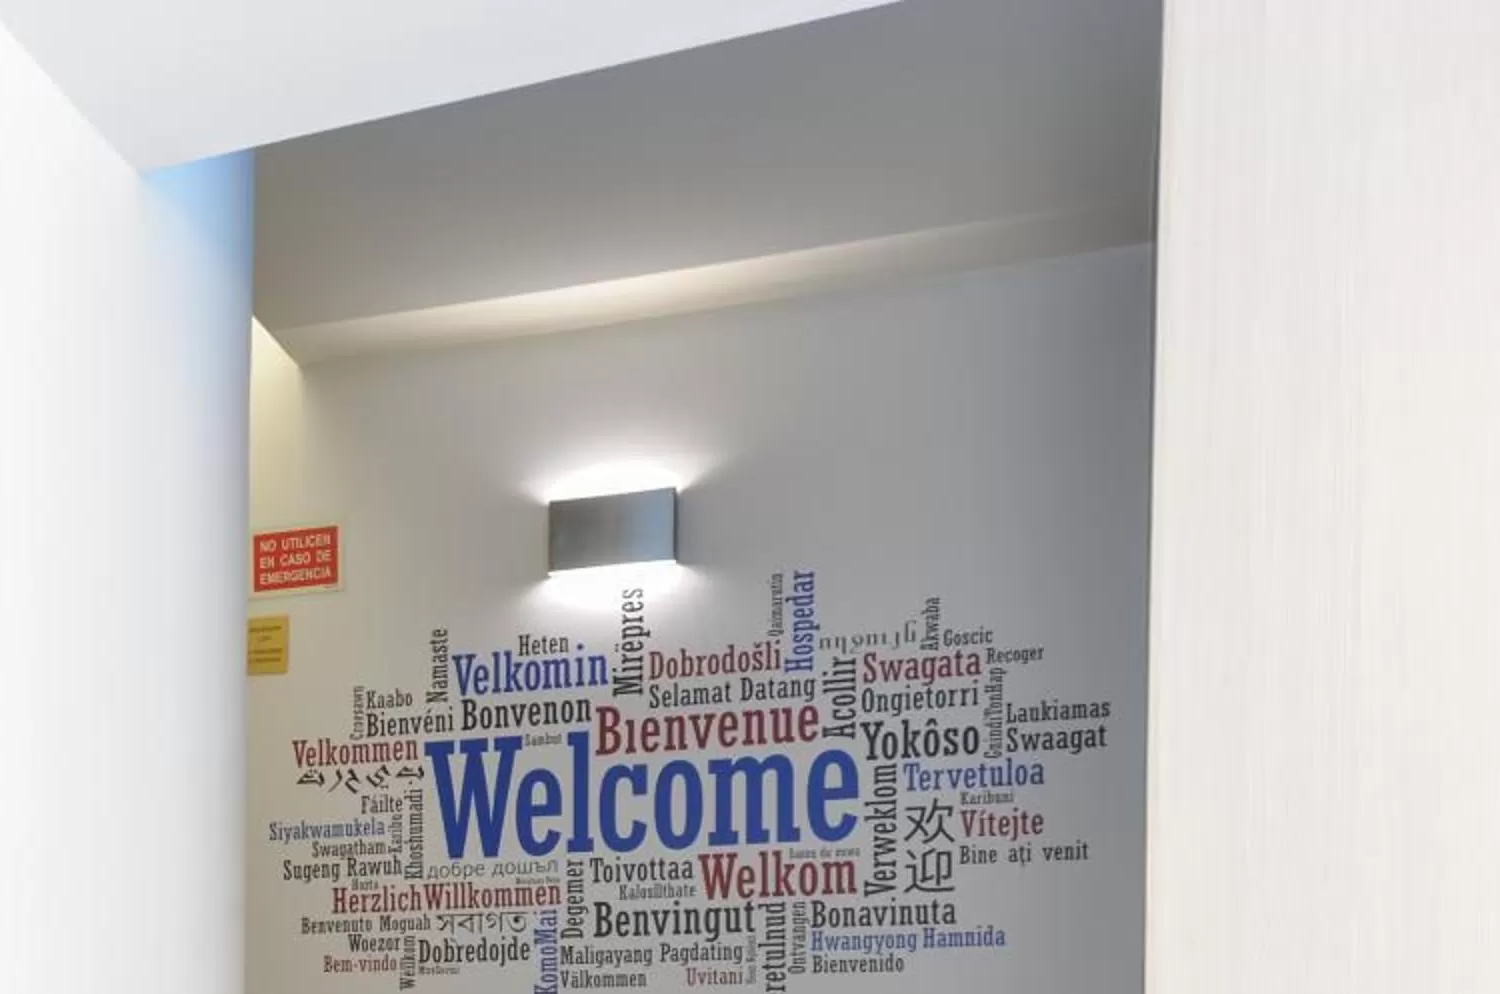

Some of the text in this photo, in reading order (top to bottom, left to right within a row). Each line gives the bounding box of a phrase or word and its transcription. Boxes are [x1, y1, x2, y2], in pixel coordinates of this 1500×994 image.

[260, 533, 331, 553] NO UTILICEN
[260, 549, 332, 569] EN CASO DE
[260, 565, 331, 585] EMERGENCIA
[784, 570, 820, 673] Hospedar
[518, 634, 569, 656] Heten
[612, 588, 651, 697] Mirëpres
[986, 647, 1044, 665] Recoger
[425, 627, 448, 703] Namaste
[451, 643, 609, 697] Velkomin
[648, 639, 781, 681] Dobrodošli
[863, 649, 981, 687] Swagata
[366, 688, 413, 709] Kaabo
[650, 677, 817, 709] Selamat Datang
[821, 656, 856, 739] Acollir
[861, 679, 979, 717] Ongietorri
[366, 706, 455, 738] Bienvéni
[460, 698, 592, 731] Bonvenon
[1006, 697, 1111, 724] Laukiamas
[595, 705, 819, 756] Bienvenue
[859, 717, 980, 761] Yokôso
[1006, 725, 1107, 755] Swaagat
[291, 737, 418, 768] Velkommen
[903, 757, 1045, 791] Tervetuloa
[360, 794, 403, 815] Fáilte
[424, 731, 861, 860] Welcome
[269, 816, 385, 846] Siyakwamukela
[863, 762, 898, 898] Verweklom
[959, 807, 1044, 841] Vítejte
[312, 839, 386, 860] Swagatham
[903, 798, 956, 894] 欢迎
[959, 844, 998, 865] Bine
[1042, 840, 1089, 862] venit
[283, 854, 403, 883] Sugeng Rawuh
[427, 859, 558, 880] добре дошъл
[589, 856, 693, 884] Toivottaa
[698, 850, 857, 901] Welkom
[560, 859, 588, 940] Degemer
[810, 897, 957, 928] Bonavinuta
[301, 916, 372, 935] Benvenuto
[593, 900, 756, 943] Benvingut
[348, 934, 401, 952] Woezor
[418, 936, 531, 967] Dobredojde
[560, 945, 653, 968] Maligayang
[659, 941, 743, 966] Pagdating
[810, 925, 1006, 956] Hwangyong Hamnida
[323, 954, 397, 973] Bem-vindo
[560, 969, 647, 989] Välkommen
[685, 966, 743, 987] Uvitani
[812, 953, 905, 974] Bienvenido
